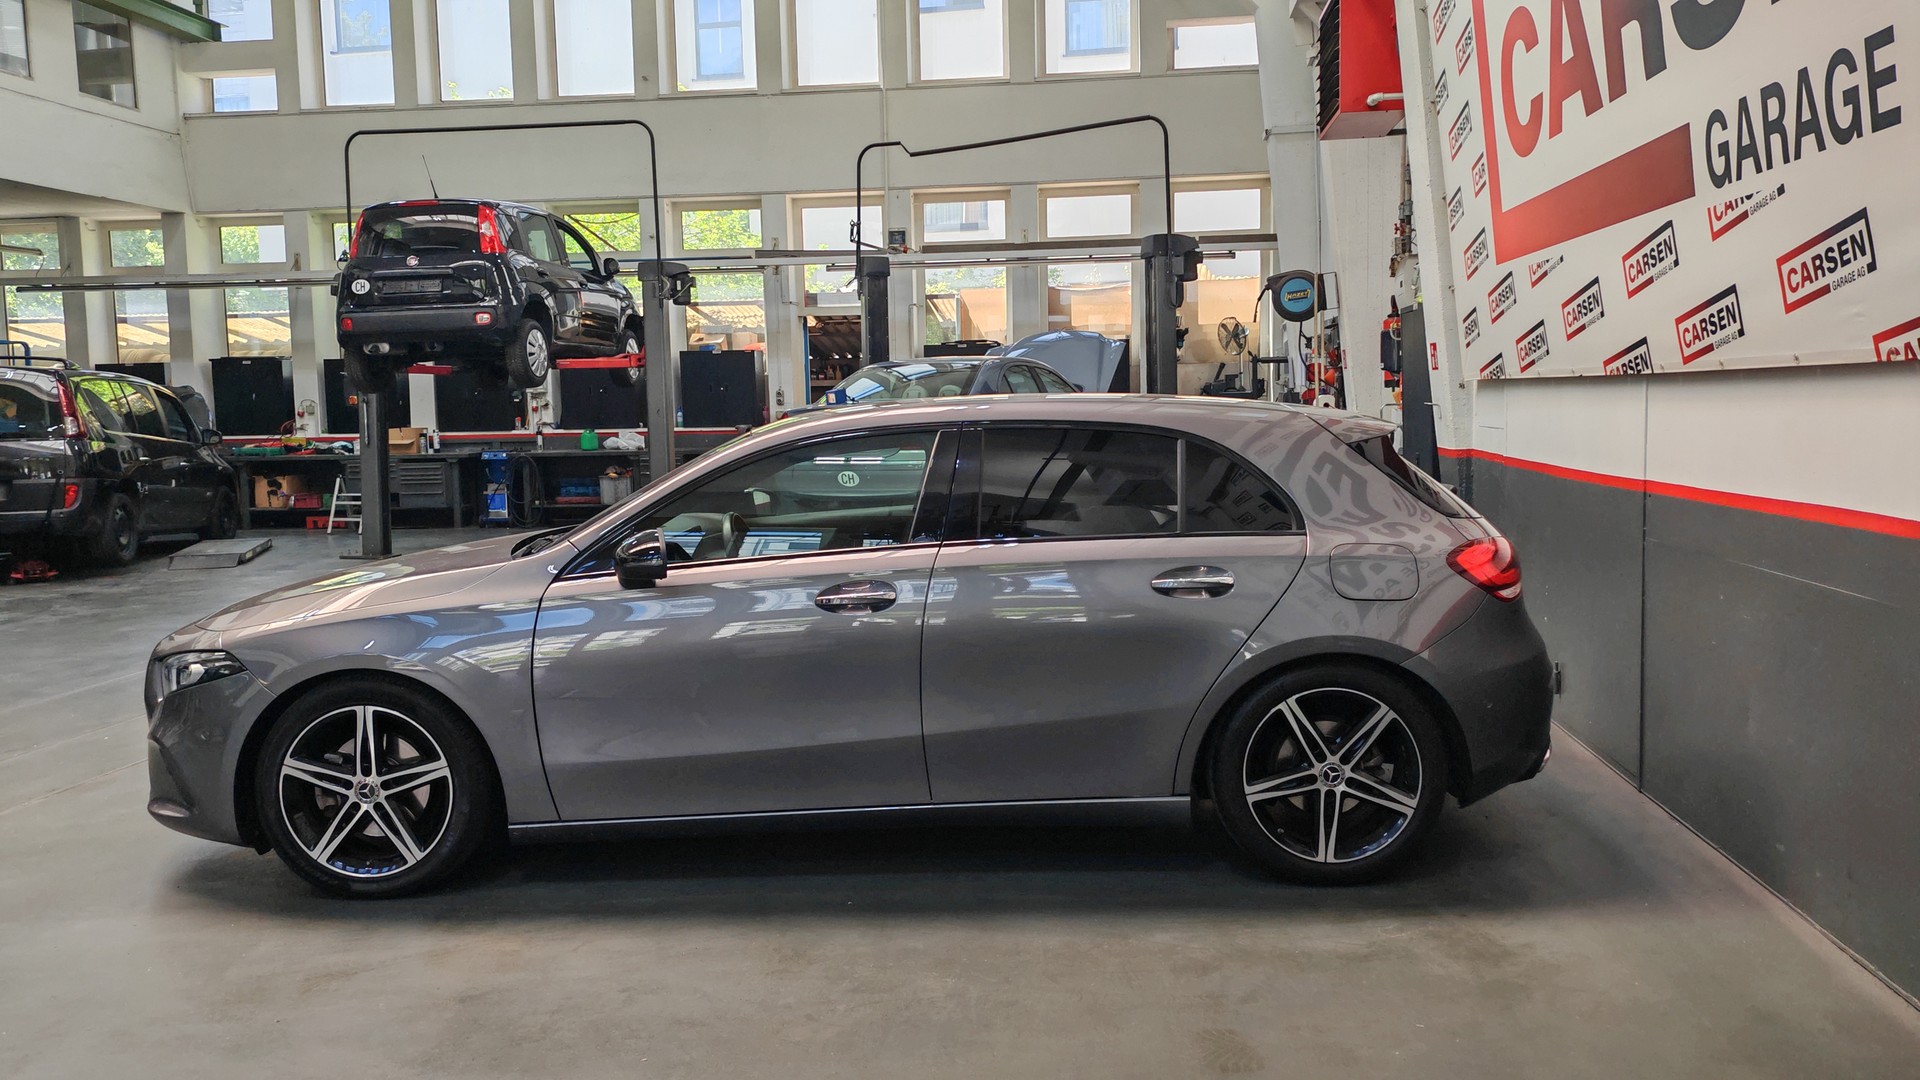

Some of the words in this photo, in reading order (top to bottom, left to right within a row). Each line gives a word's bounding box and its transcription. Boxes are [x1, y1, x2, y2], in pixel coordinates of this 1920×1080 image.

[1705, 24, 1902, 189] GARAGE
[1749, 194, 1768, 216] GARAGE
[1769, 190, 1777, 203] AG
[1466, 240, 1486, 270] CARSEN
[1628, 235, 1673, 284] CARSEN
[1786, 229, 1867, 294] CARSEN
[355, 282, 366, 292] CH
[1831, 271, 1857, 292] GARAGE
[1857, 265, 1867, 280] AG
[1490, 281, 1514, 313] CARSEN
[1566, 290, 1600, 328] CARSEN
[1682, 301, 1737, 349] CARSEN
[1714, 335, 1731, 349] GARAGE
[1731, 331, 1738, 342] AG
[1519, 331, 1545, 362] CARSEN
[840, 473, 855, 485] CH
